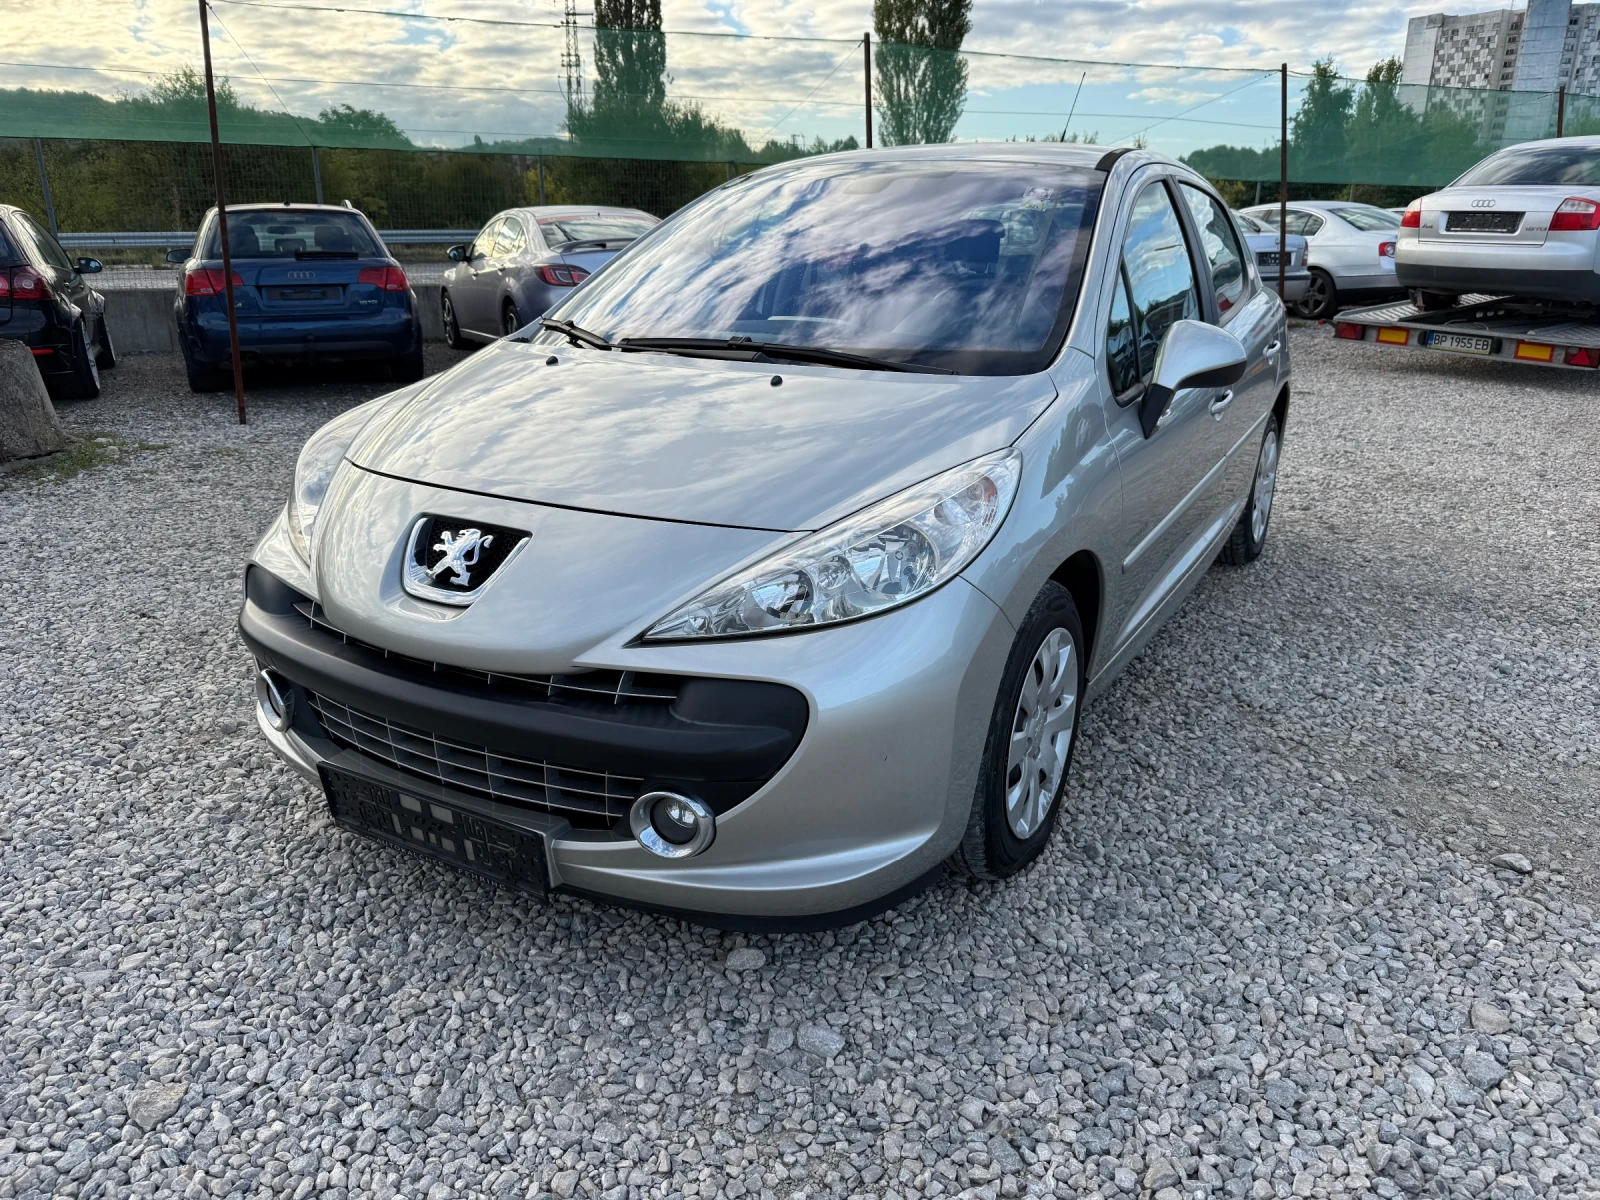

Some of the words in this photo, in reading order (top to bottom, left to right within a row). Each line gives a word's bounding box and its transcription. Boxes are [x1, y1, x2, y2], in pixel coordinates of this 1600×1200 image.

[1433, 334, 1447, 346] BP
[1450, 336, 1473, 349] 1955
[1474, 338, 1489, 351] EB
